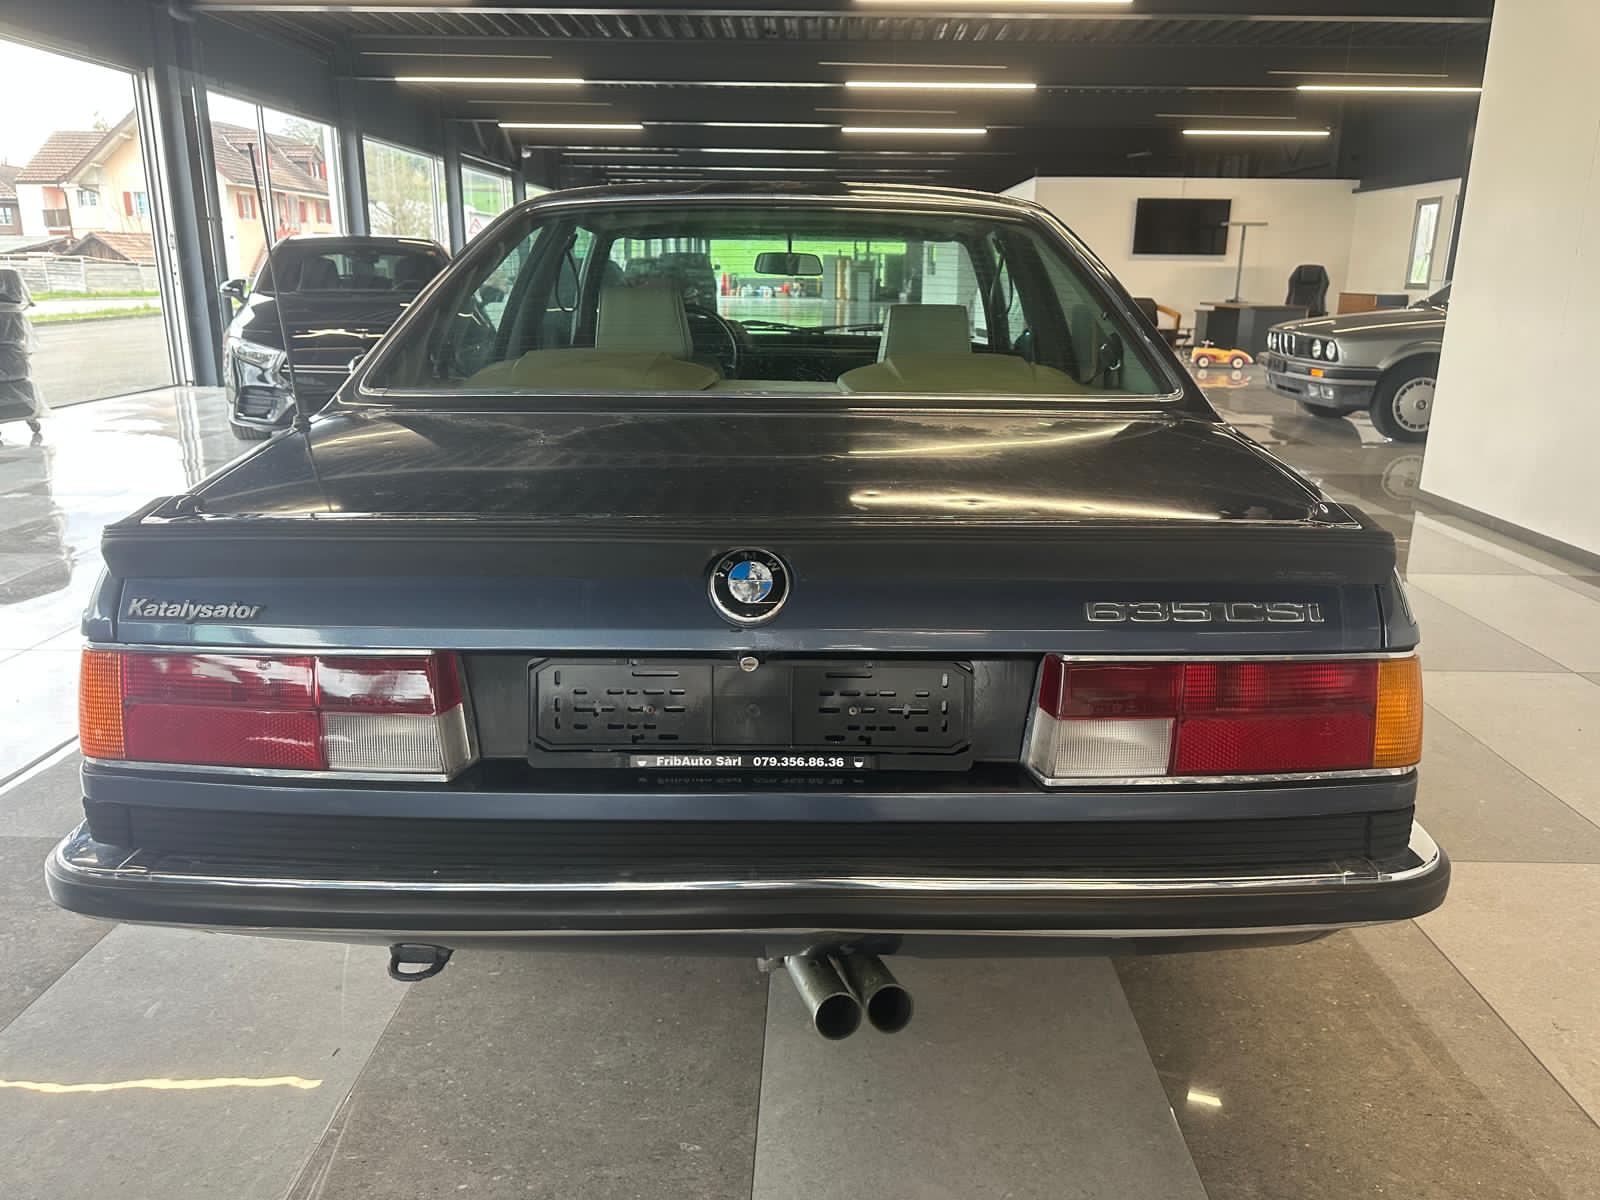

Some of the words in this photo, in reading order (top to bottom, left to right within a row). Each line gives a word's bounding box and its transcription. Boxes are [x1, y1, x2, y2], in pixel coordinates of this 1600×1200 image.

[720, 551, 781, 572] BMW
[128, 598, 262, 620] Katalysator
[1085, 600, 1212, 623] 635
[656, 756, 712, 767] FribAuto
[752, 756, 845, 768] 079.356.86.36
